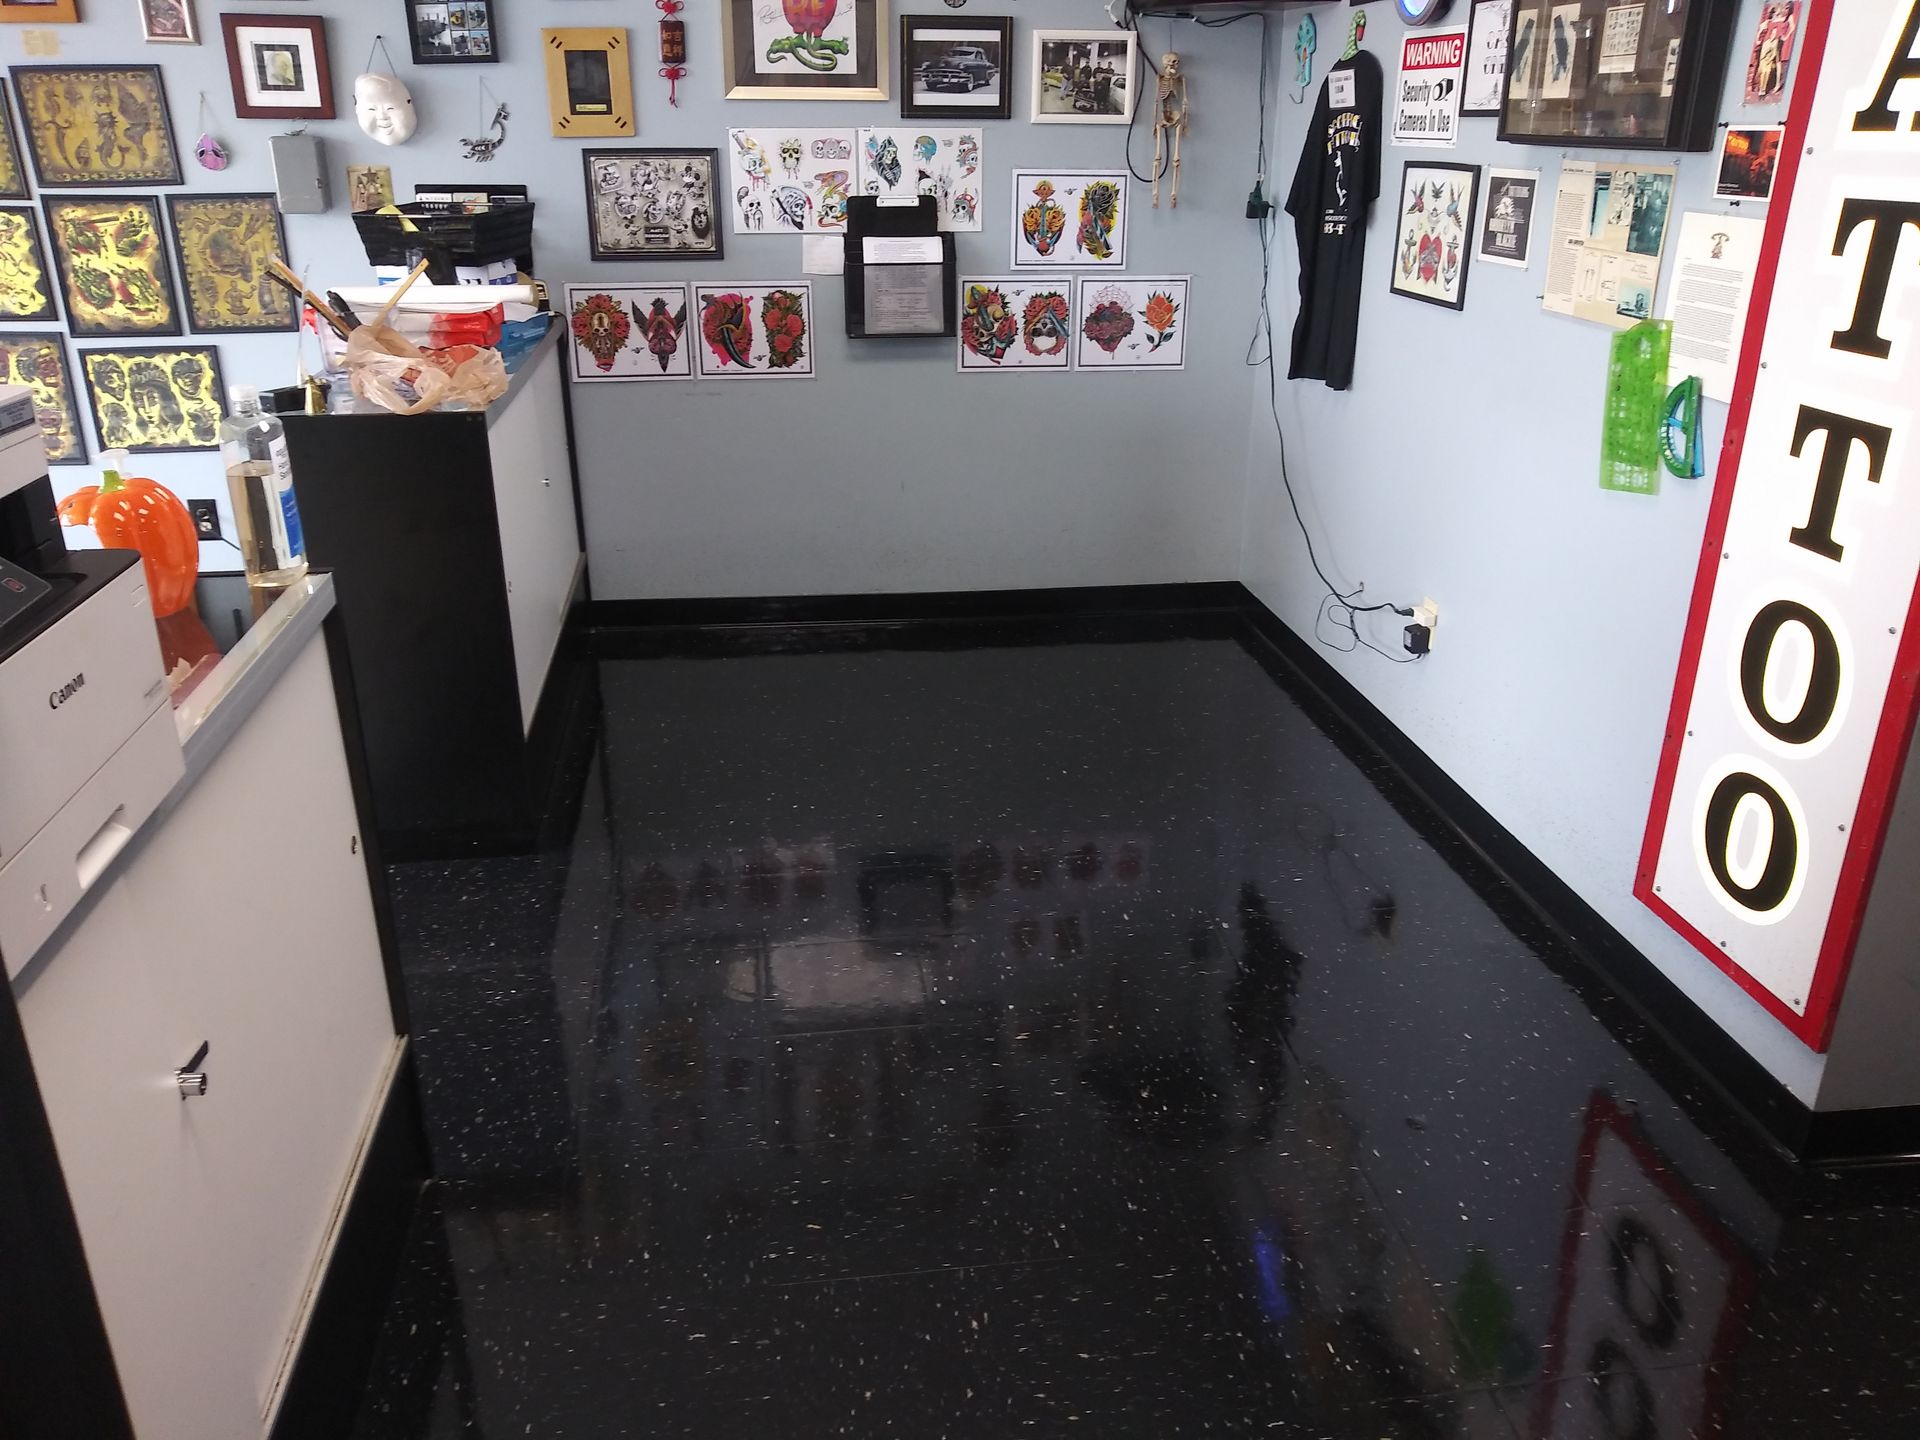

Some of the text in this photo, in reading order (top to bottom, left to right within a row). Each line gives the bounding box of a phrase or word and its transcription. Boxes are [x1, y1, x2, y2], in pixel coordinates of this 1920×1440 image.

[1406, 39, 1462, 67] WARNING
[1402, 79, 1432, 107] Security
[1399, 109, 1427, 132] Cameras
[1428, 109, 1436, 132] In
[1437, 109, 1451, 132] Use
[49, 672, 85, 710] Canon
